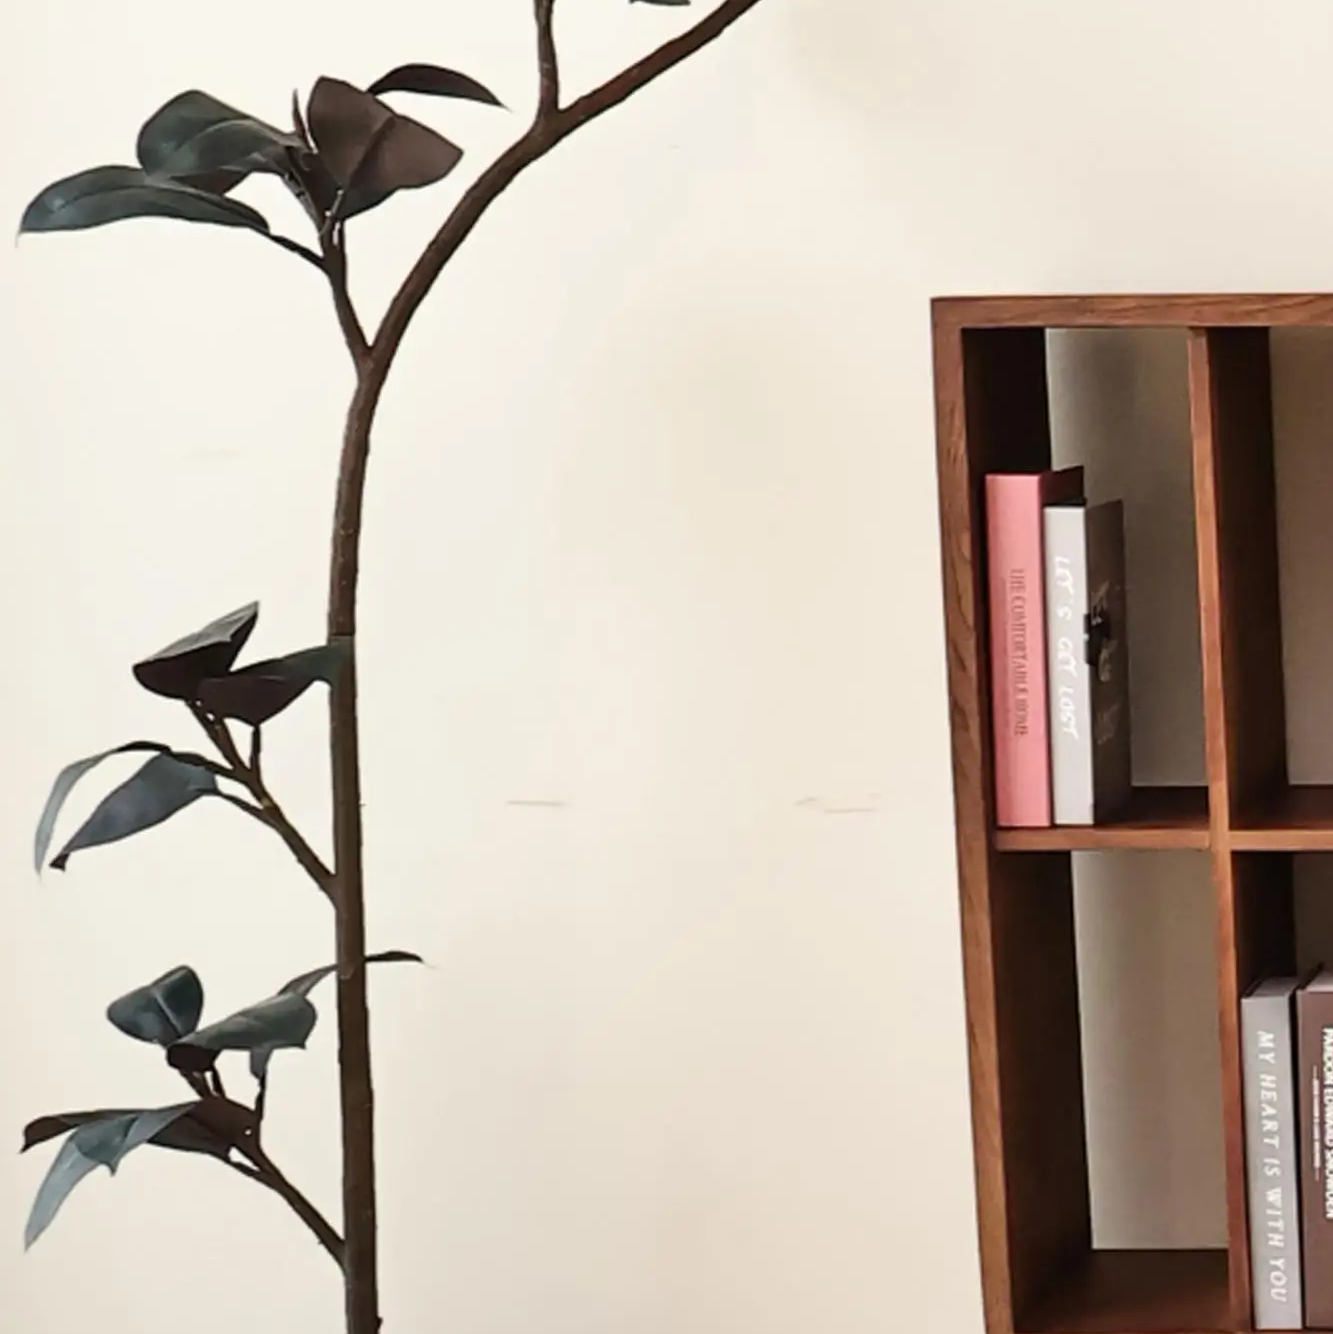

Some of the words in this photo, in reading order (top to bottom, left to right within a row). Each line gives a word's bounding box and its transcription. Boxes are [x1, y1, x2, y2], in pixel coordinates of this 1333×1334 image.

[1057, 636, 1078, 679] GET
[1058, 685, 1079, 740] LOST
[1256, 1030, 1277, 1064] MY
[1259, 1072, 1281, 1149] HEART
[1263, 1157, 1282, 1178] IS
[1265, 1186, 1285, 1249] WITH
[1268, 1257, 1288, 1304] YOU
